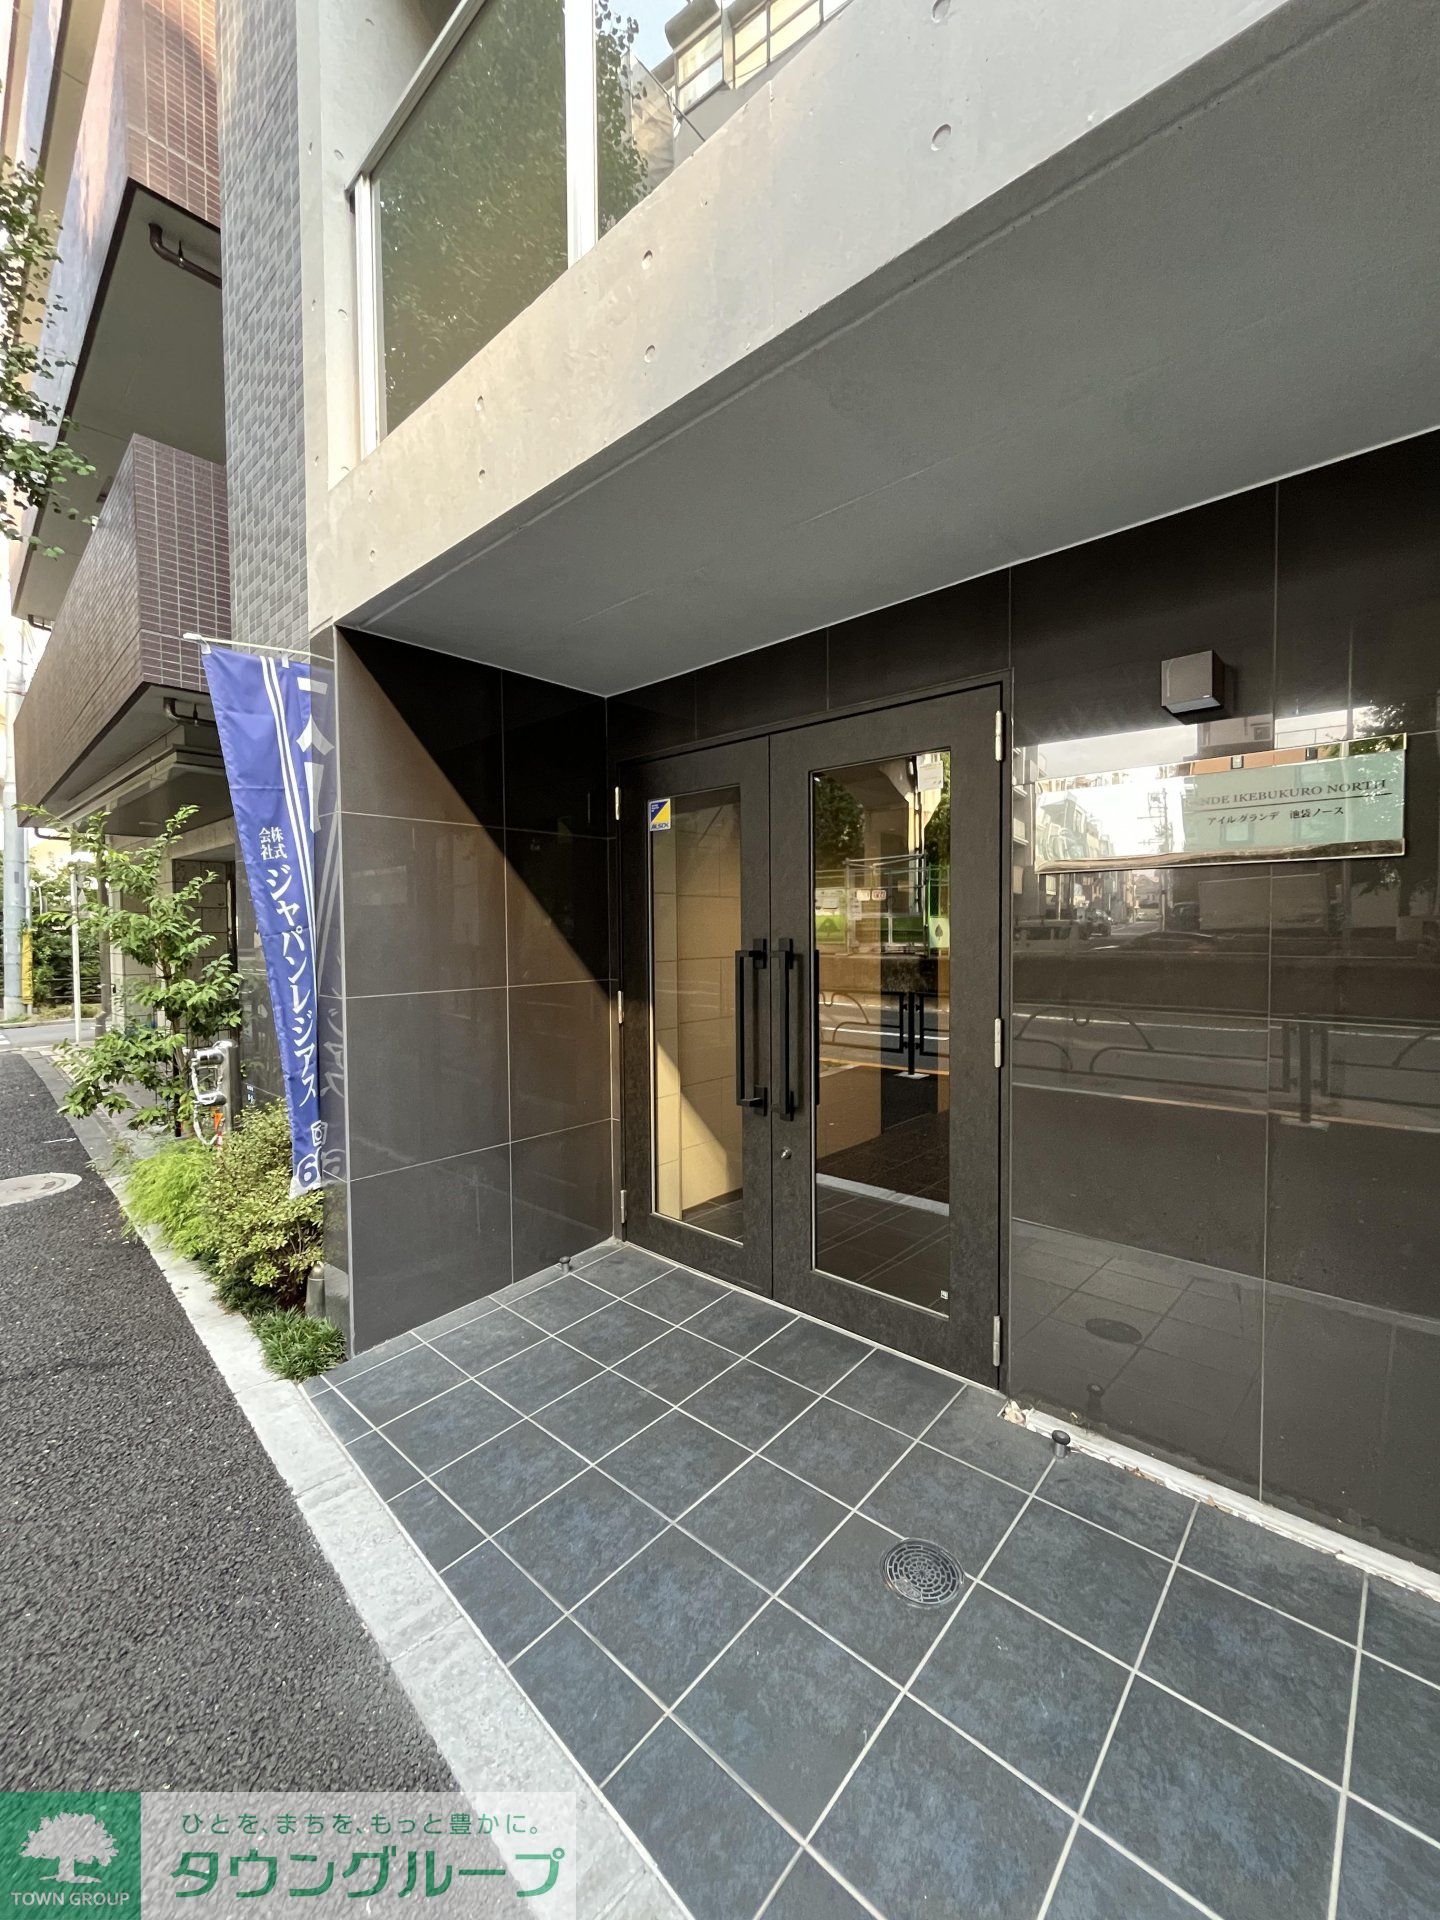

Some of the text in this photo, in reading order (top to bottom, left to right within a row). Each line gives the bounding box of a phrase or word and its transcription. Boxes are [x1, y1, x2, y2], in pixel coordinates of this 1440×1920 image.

[1233, 786, 1323, 803] IKEBUKURO
[1327, 779, 1387, 794] NORTH
[1208, 806, 1344, 826] アイルグランデ 池袋ノース
[266, 864, 316, 1108] ジャパンレジアス
